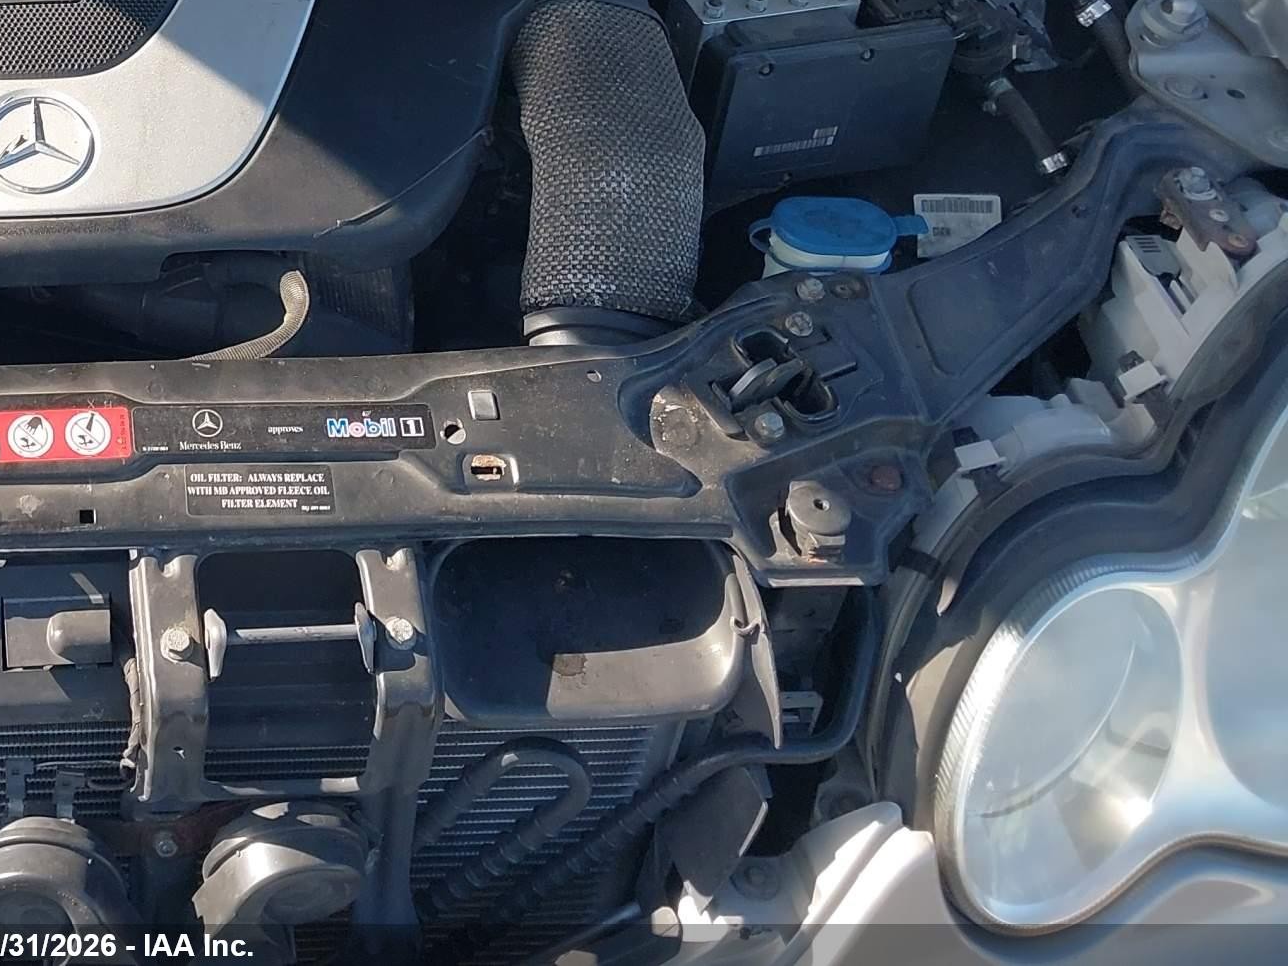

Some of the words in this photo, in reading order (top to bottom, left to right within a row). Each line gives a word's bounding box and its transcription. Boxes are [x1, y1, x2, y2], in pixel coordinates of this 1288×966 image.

[267, 426, 304, 435] approves
[327, 417, 397, 438] Mobil
[190, 473, 207, 483] OIL
[208, 473, 243, 483] FILTER:
[248, 473, 283, 483] ALWAYS
[284, 473, 325, 483] REPLACE
[187, 486, 212, 495] WITH
[214, 486, 229, 495] MB
[229, 486, 277, 495] APPROVED
[277, 486, 313, 495] FLEECE
[314, 486, 330, 495] OIL
[222, 499, 254, 509] FILTER
[255, 499, 298, 509] ELEMENT
